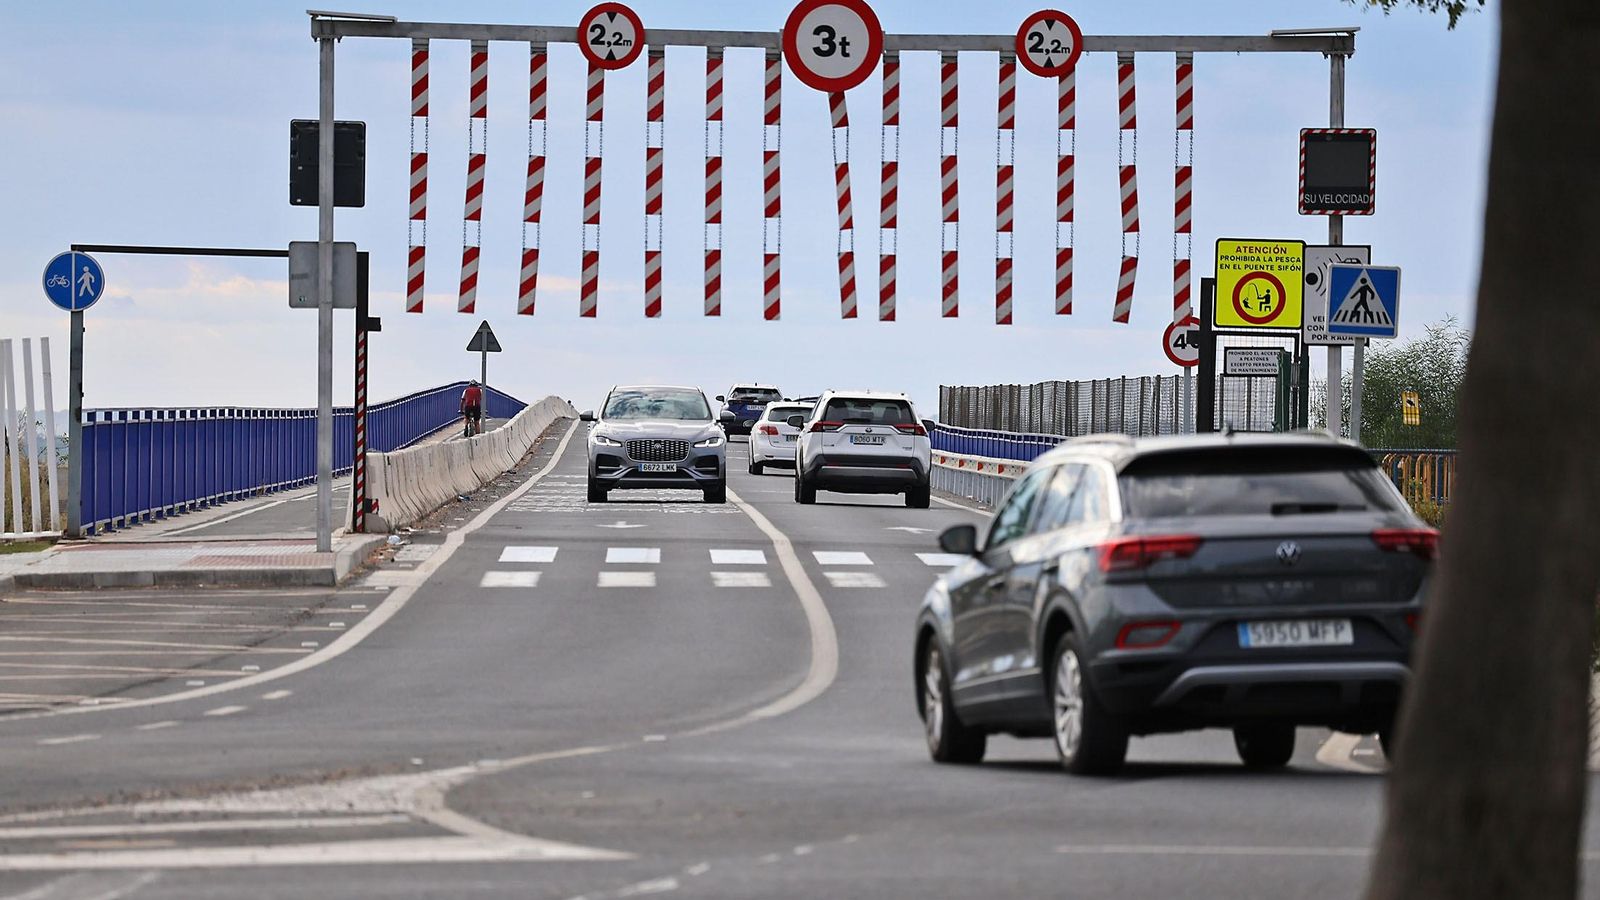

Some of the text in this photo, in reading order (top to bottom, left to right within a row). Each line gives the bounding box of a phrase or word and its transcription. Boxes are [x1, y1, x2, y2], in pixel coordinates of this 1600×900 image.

[590, 24, 632, 48] 2,2m
[1028, 31, 1070, 55] 2,2m
[1304, 193, 1370, 204] SU VELOCIDAD
[1235, 244, 1288, 255] ATENCIÓN
[1219, 255, 1261, 263] PROHIBIDA
[1277, 263, 1301, 271] SIFÓN
[1173, 333, 1199, 349] 4
[1251, 622, 1301, 645] 5950
